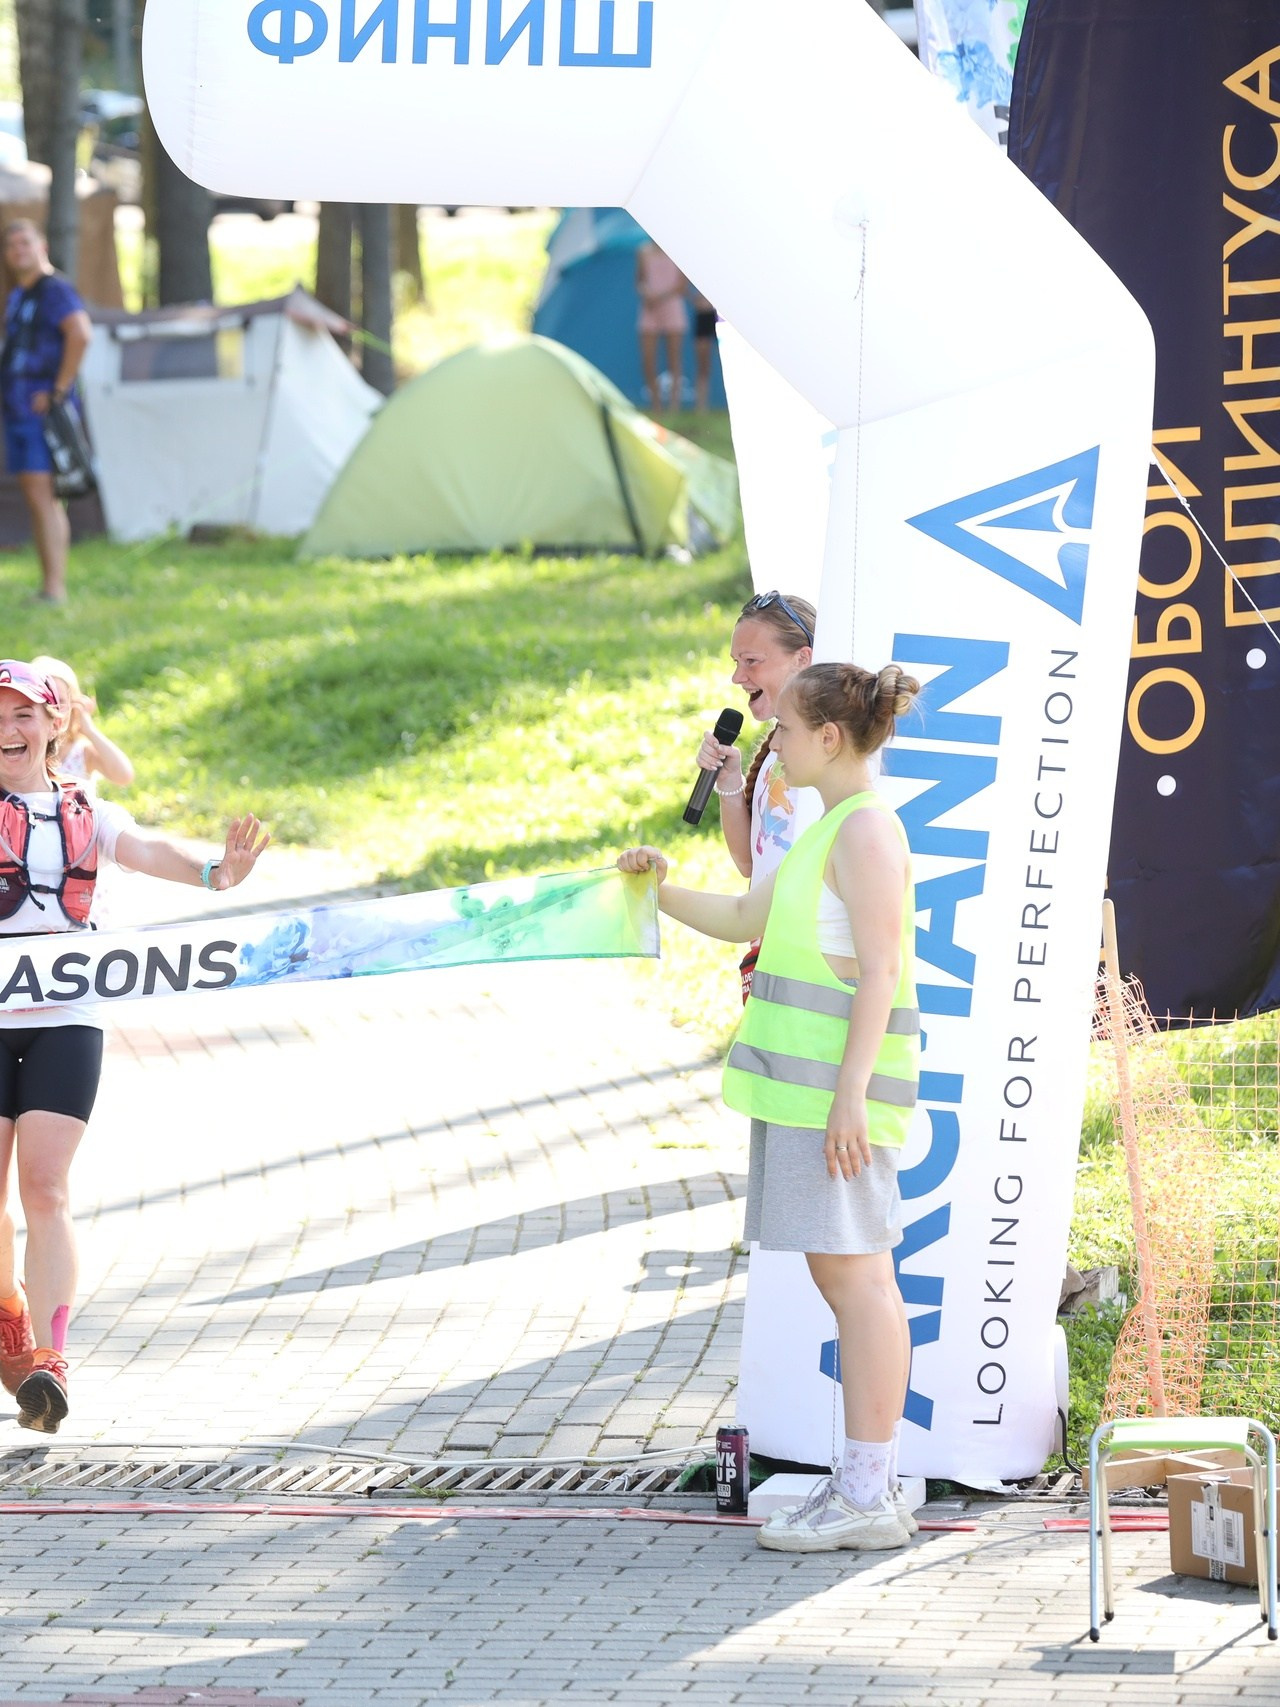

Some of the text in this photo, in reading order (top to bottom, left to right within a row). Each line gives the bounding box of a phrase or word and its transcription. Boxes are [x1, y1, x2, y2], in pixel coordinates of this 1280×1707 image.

[247, 0, 654, 68] ФИНИШ
[1222, 43, 1280, 628] ПЛИНТУСА
[1127, 426, 1207, 755] ОБОИ
[972, 648, 1079, 1425] LOOKING FOR PERFECTION
[716, 1466, 737, 1483] UP
